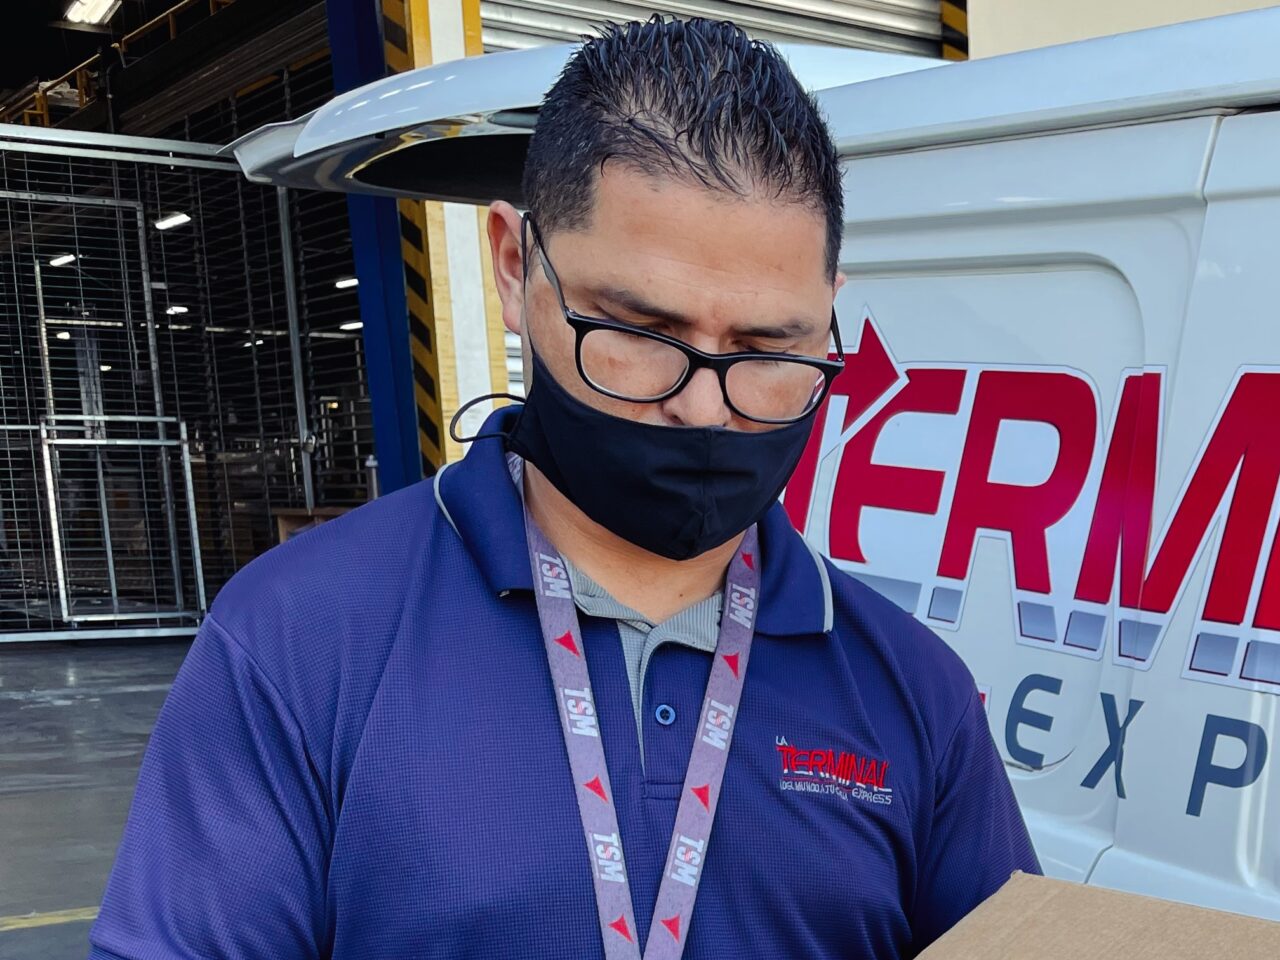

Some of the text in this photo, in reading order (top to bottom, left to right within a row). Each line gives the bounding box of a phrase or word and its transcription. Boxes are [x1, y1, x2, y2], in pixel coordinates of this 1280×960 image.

[535, 553, 572, 599] TSM
[727, 583, 755, 629] TSM
[564, 688, 598, 737] TSM
[698, 698, 735, 750] TSM
[775, 735, 788, 746] LA
[776, 745, 893, 792] TERMINAL
[593, 832, 626, 885] TSM
[671, 834, 705, 887] TSM
